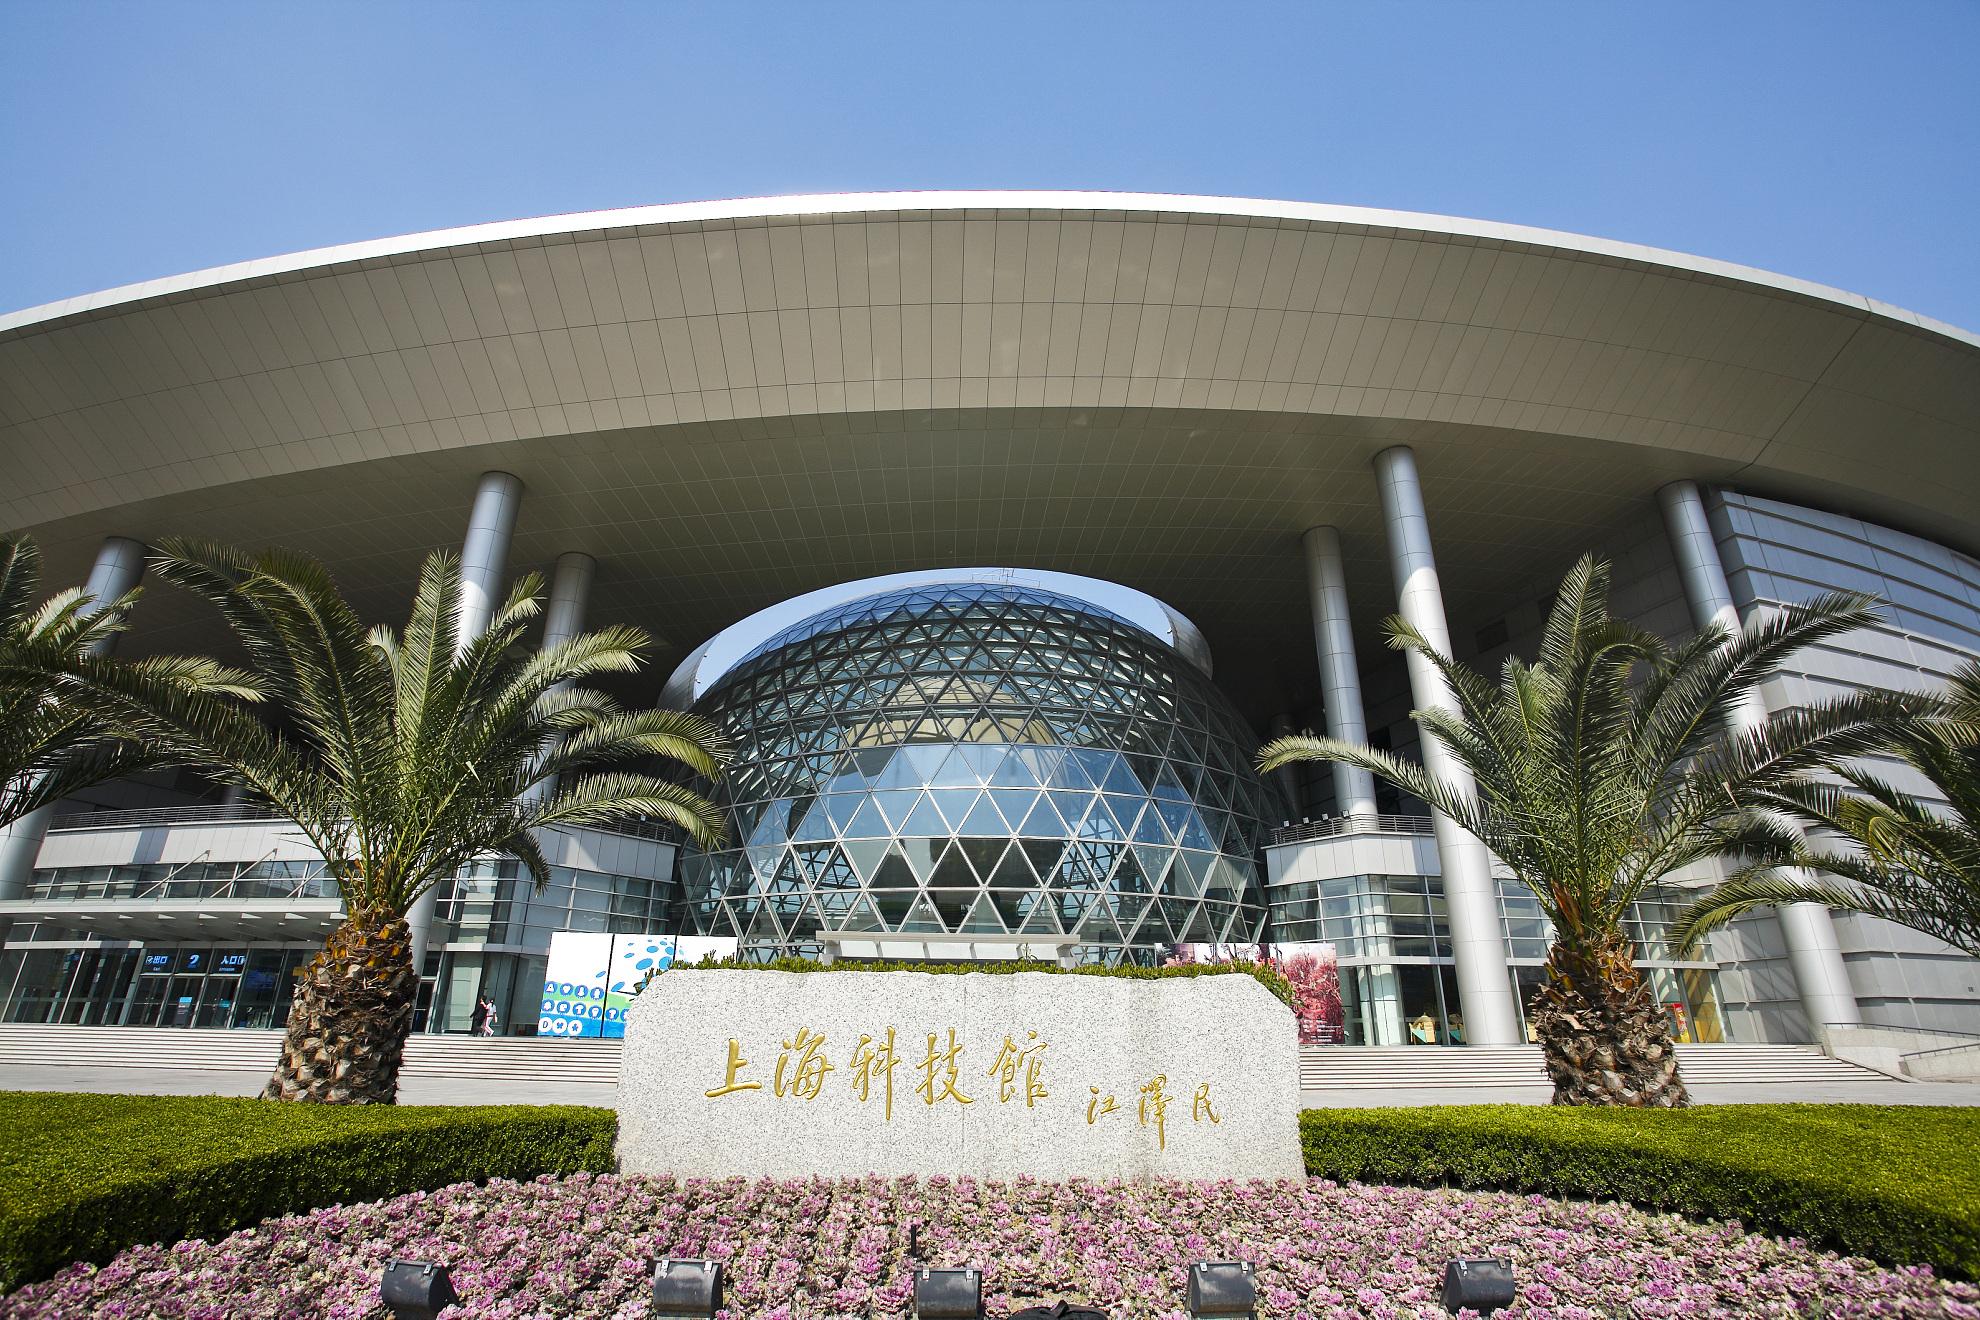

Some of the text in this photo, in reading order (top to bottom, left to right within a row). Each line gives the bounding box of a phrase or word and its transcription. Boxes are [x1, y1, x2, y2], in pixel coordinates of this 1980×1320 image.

[220, 955, 238, 965] 入口
[705, 1025, 1049, 1122] 上海科技館
[1085, 1072, 1221, 1151] 江澤民
